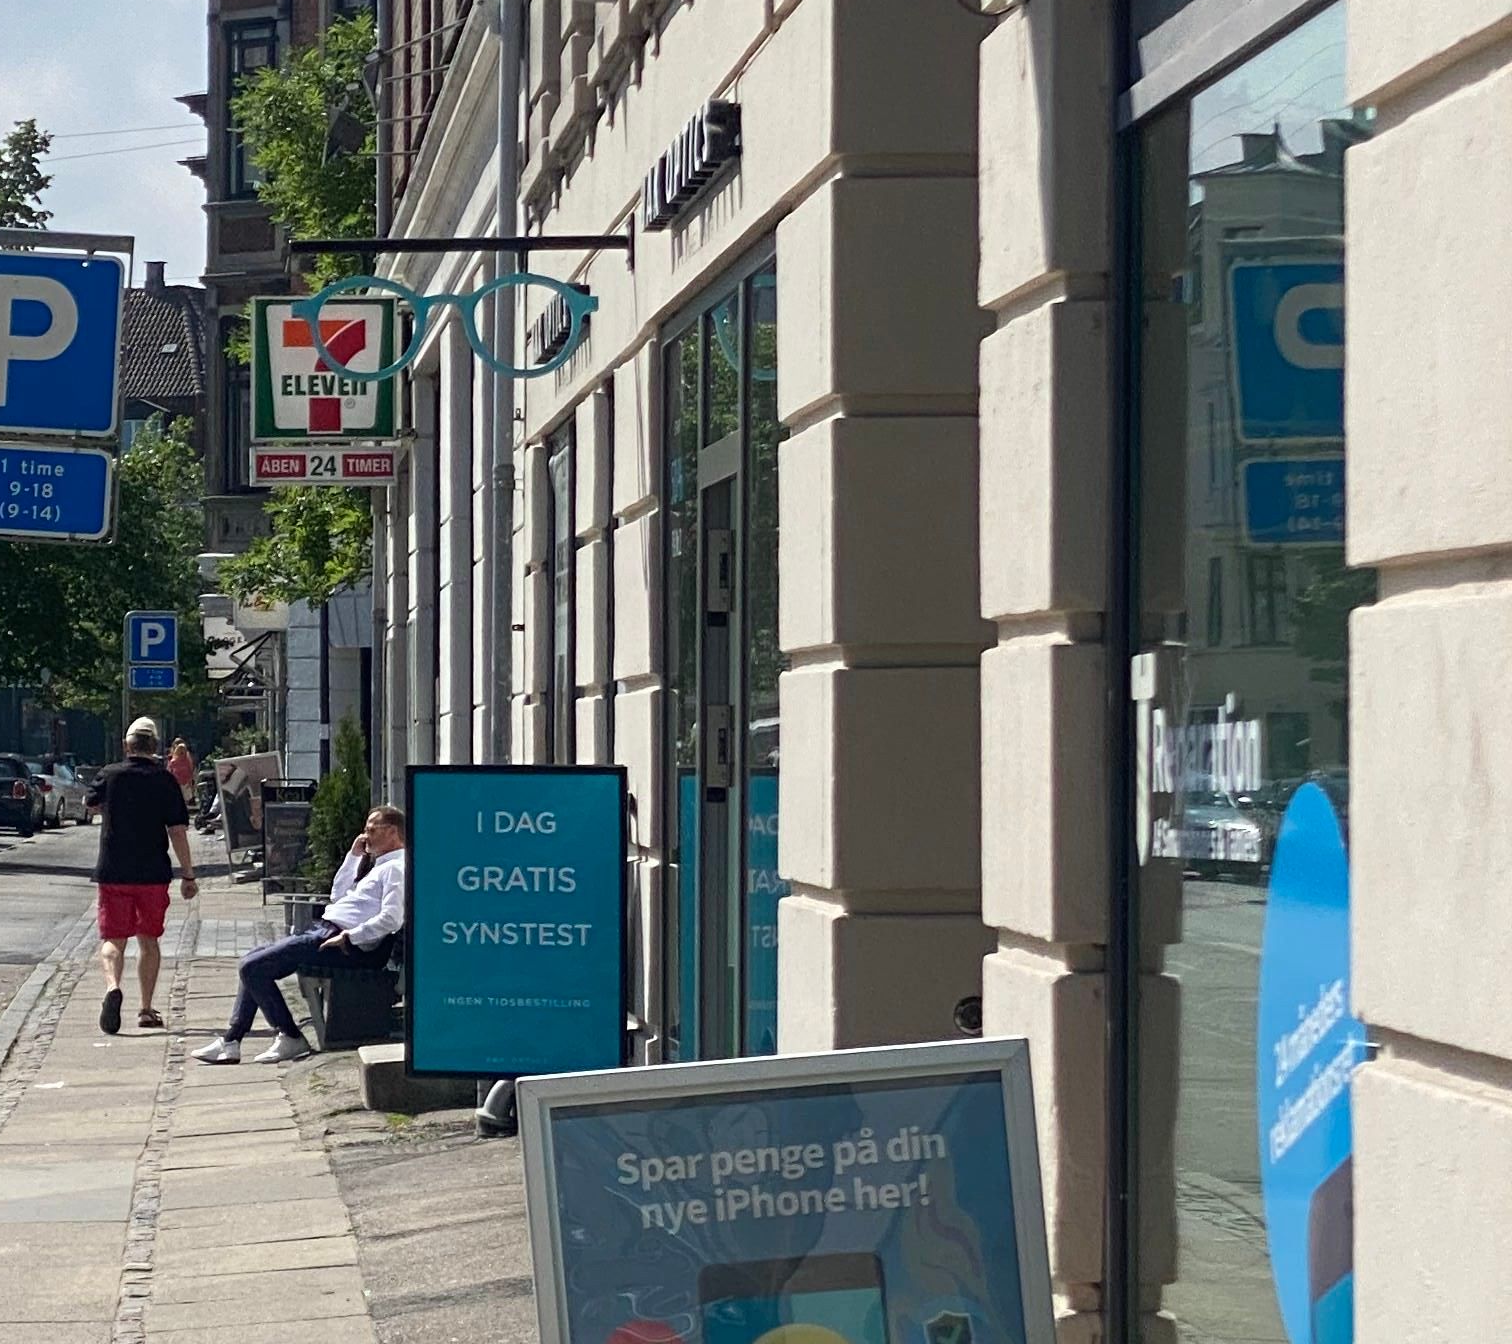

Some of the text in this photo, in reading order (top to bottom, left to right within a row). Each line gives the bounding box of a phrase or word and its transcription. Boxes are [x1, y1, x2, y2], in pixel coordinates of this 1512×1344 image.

[1, 458, 65, 477] 1 time
[309, 456, 337, 476] 24
[347, 458, 391, 473] TIMER
[9, 481, 54, 498] 9-18
[0, 502, 61, 523] (9-14)
[140, 622, 166, 657] P
[477, 811, 557, 834] I DAG
[457, 866, 577, 893] GRATIS
[441, 921, 592, 947] SYNSTEST
[443, 997, 591, 1008] INGEN TIDSBESTILLING
[616, 1125, 945, 1192] Spar penge på din
[641, 1173, 929, 1235] nye iPhone her!
